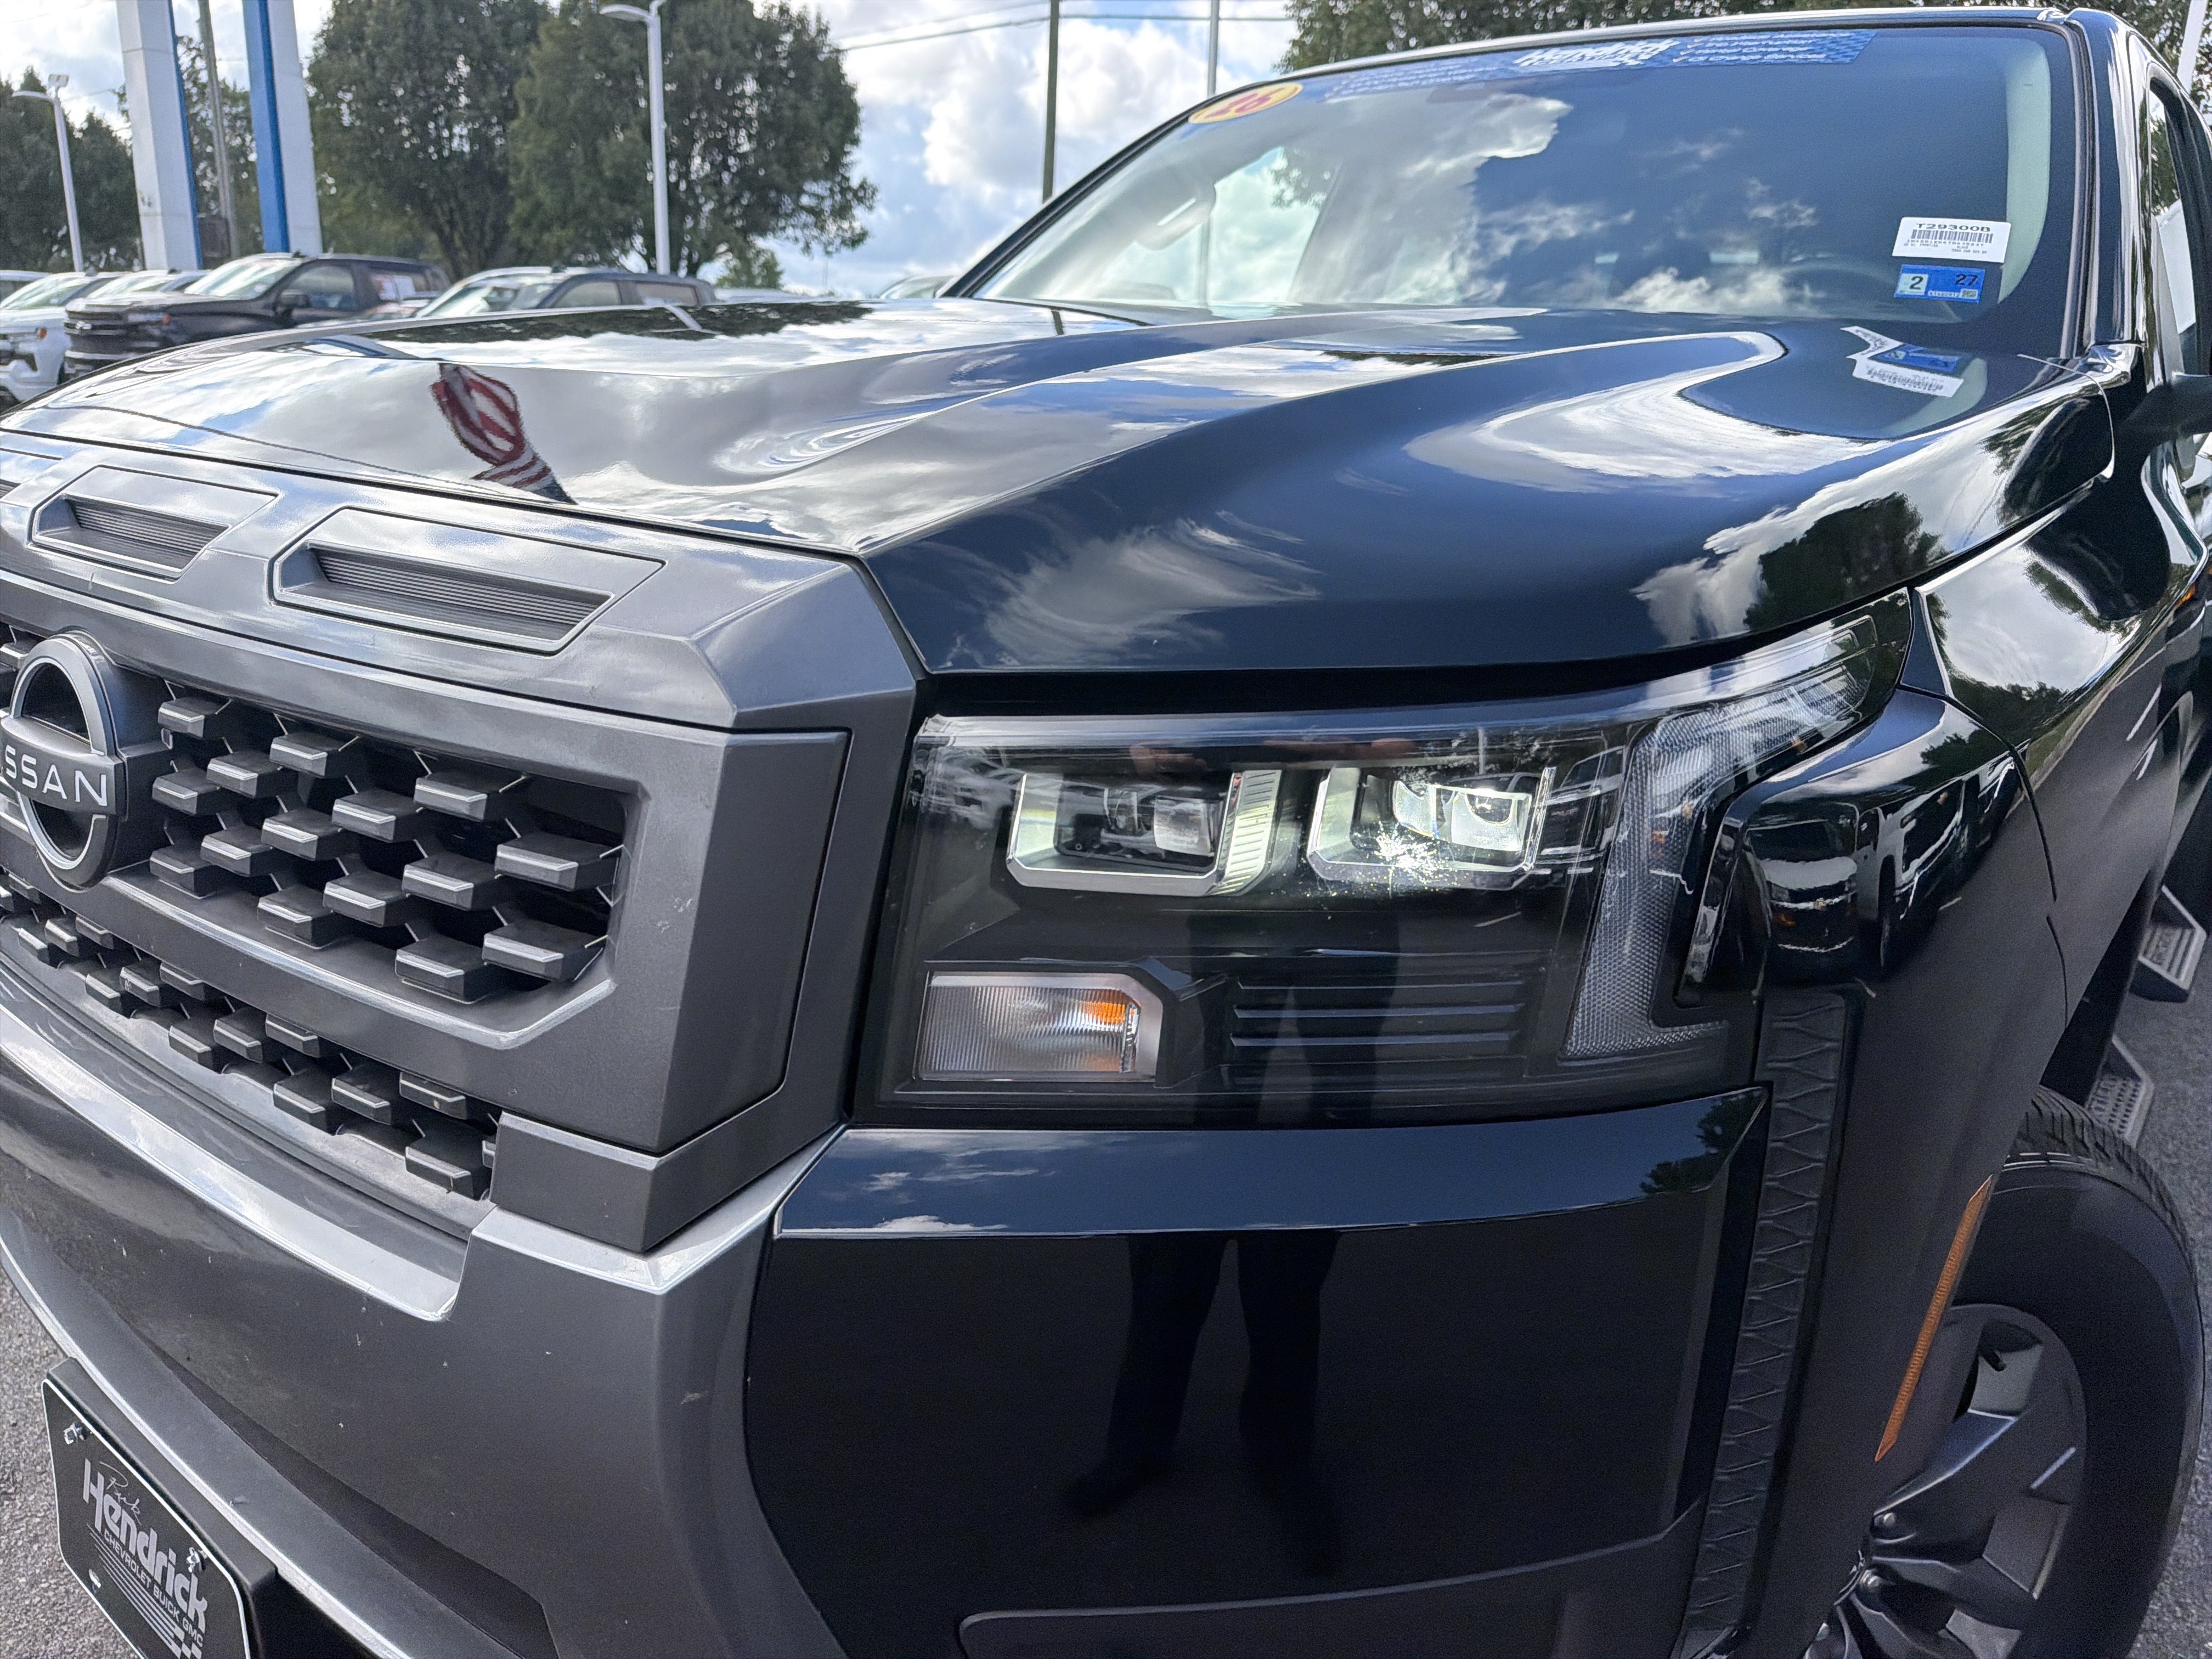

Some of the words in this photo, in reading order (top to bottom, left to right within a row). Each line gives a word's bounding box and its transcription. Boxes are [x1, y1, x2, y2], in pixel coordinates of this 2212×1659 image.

[1909, 275, 1923, 290] 2
[1955, 273, 1978, 286] 27
[4, 744, 107, 807] SSAN
[82, 1457, 208, 1634] Hendrick
[104, 1528, 151, 1588] CHEVROLET
[153, 1583, 180, 1623] BUICK
[182, 1617, 204, 1647] GMC
